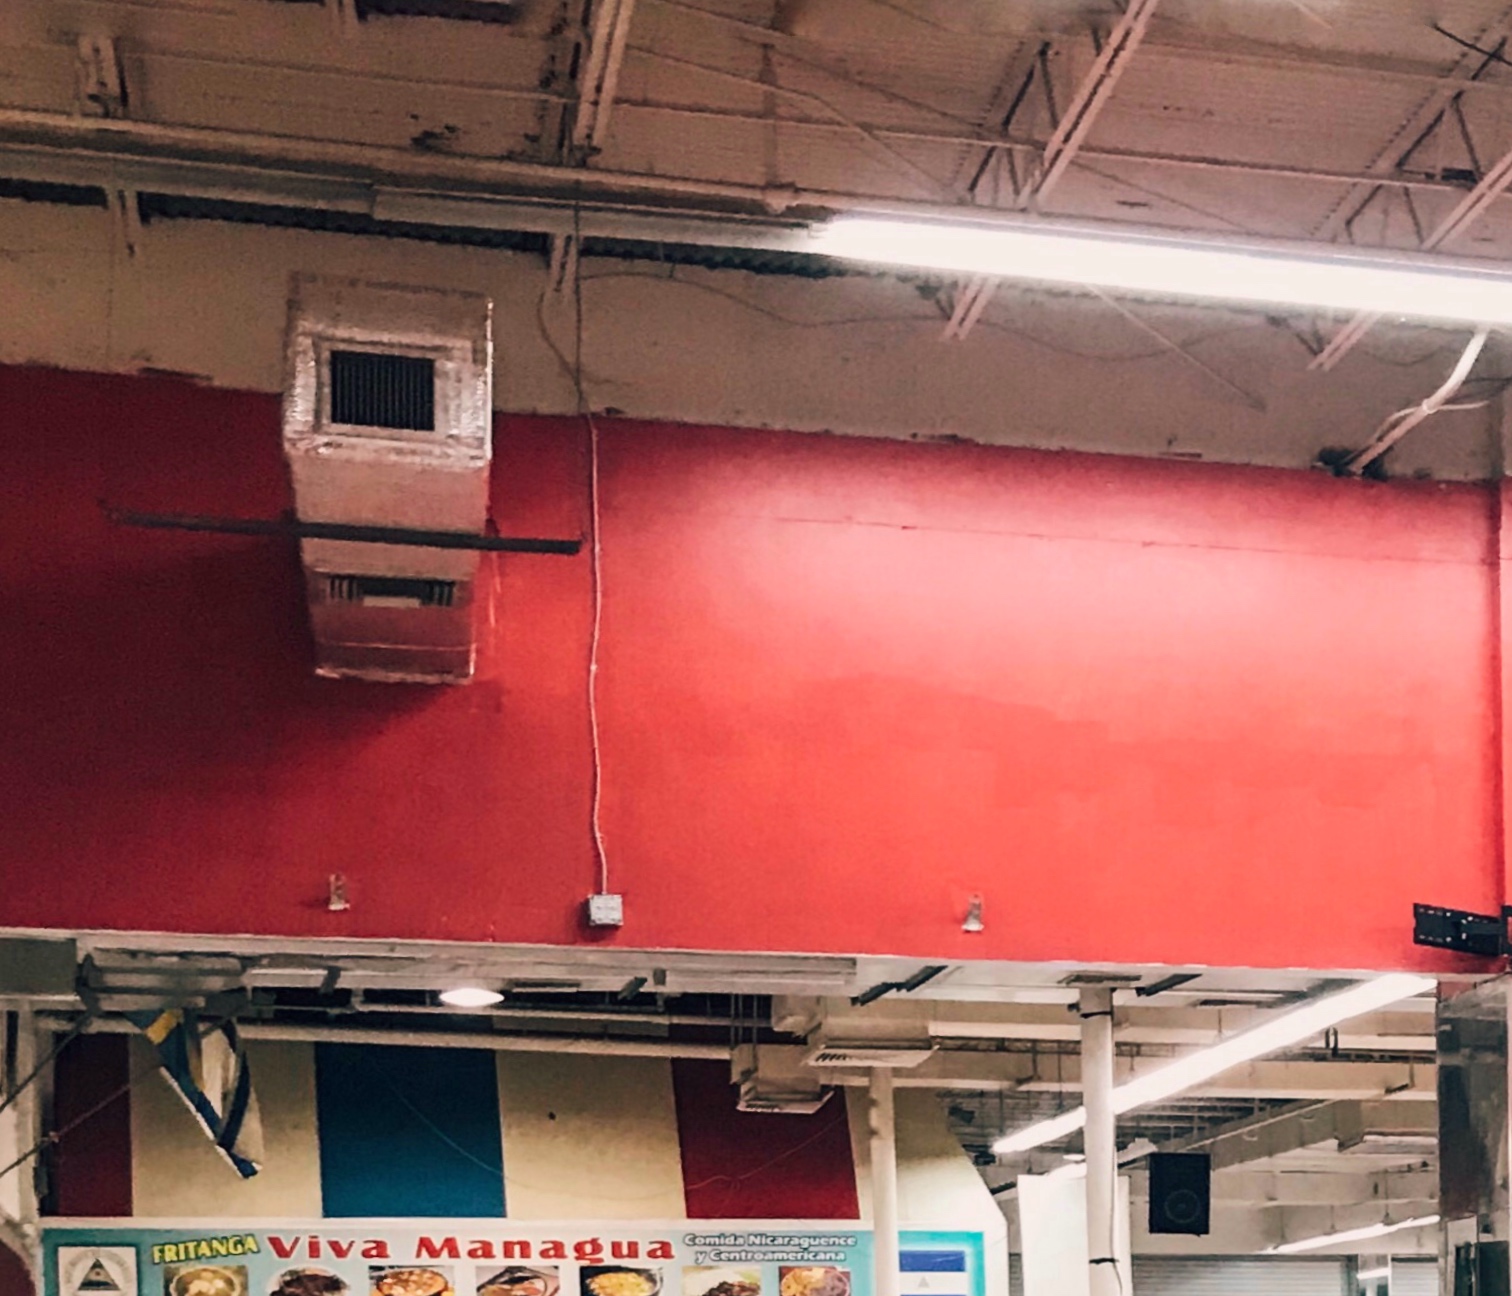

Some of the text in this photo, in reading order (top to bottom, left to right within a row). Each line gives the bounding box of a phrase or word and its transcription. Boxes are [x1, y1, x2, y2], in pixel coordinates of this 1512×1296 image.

[152, 1234, 260, 1264] FRITANGA
[266, 1235, 675, 1264] Viva Managua
[684, 1233, 858, 1249] Comida Nicaraguence
[696, 1250, 846, 1264] y Centroamericana
